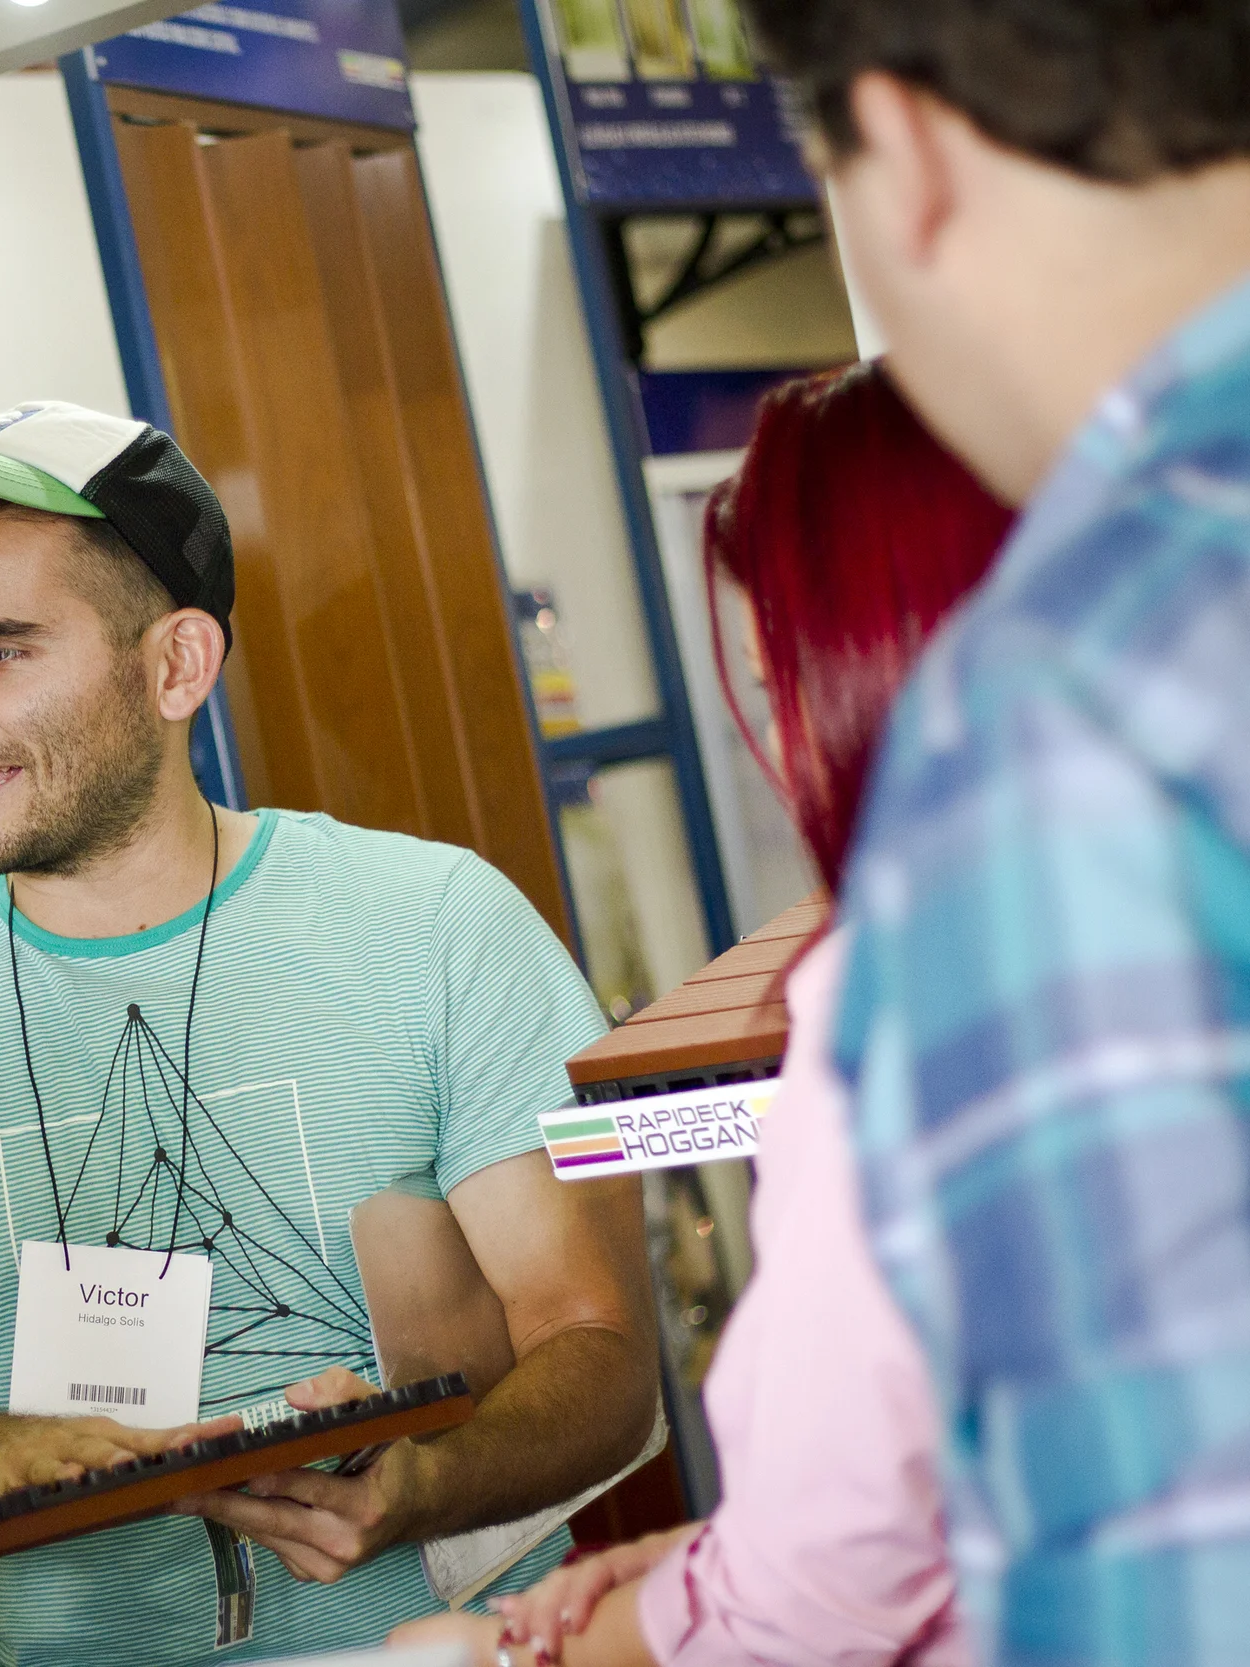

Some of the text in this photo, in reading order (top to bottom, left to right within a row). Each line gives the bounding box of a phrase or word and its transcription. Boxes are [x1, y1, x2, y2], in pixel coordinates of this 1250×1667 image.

[616, 1100, 751, 1133] RAPIDECK
[623, 1121, 759, 1159] HOGGAN
[79, 1283, 150, 1308] Victor
[78, 1312, 145, 1328] Hidalgo Solis
